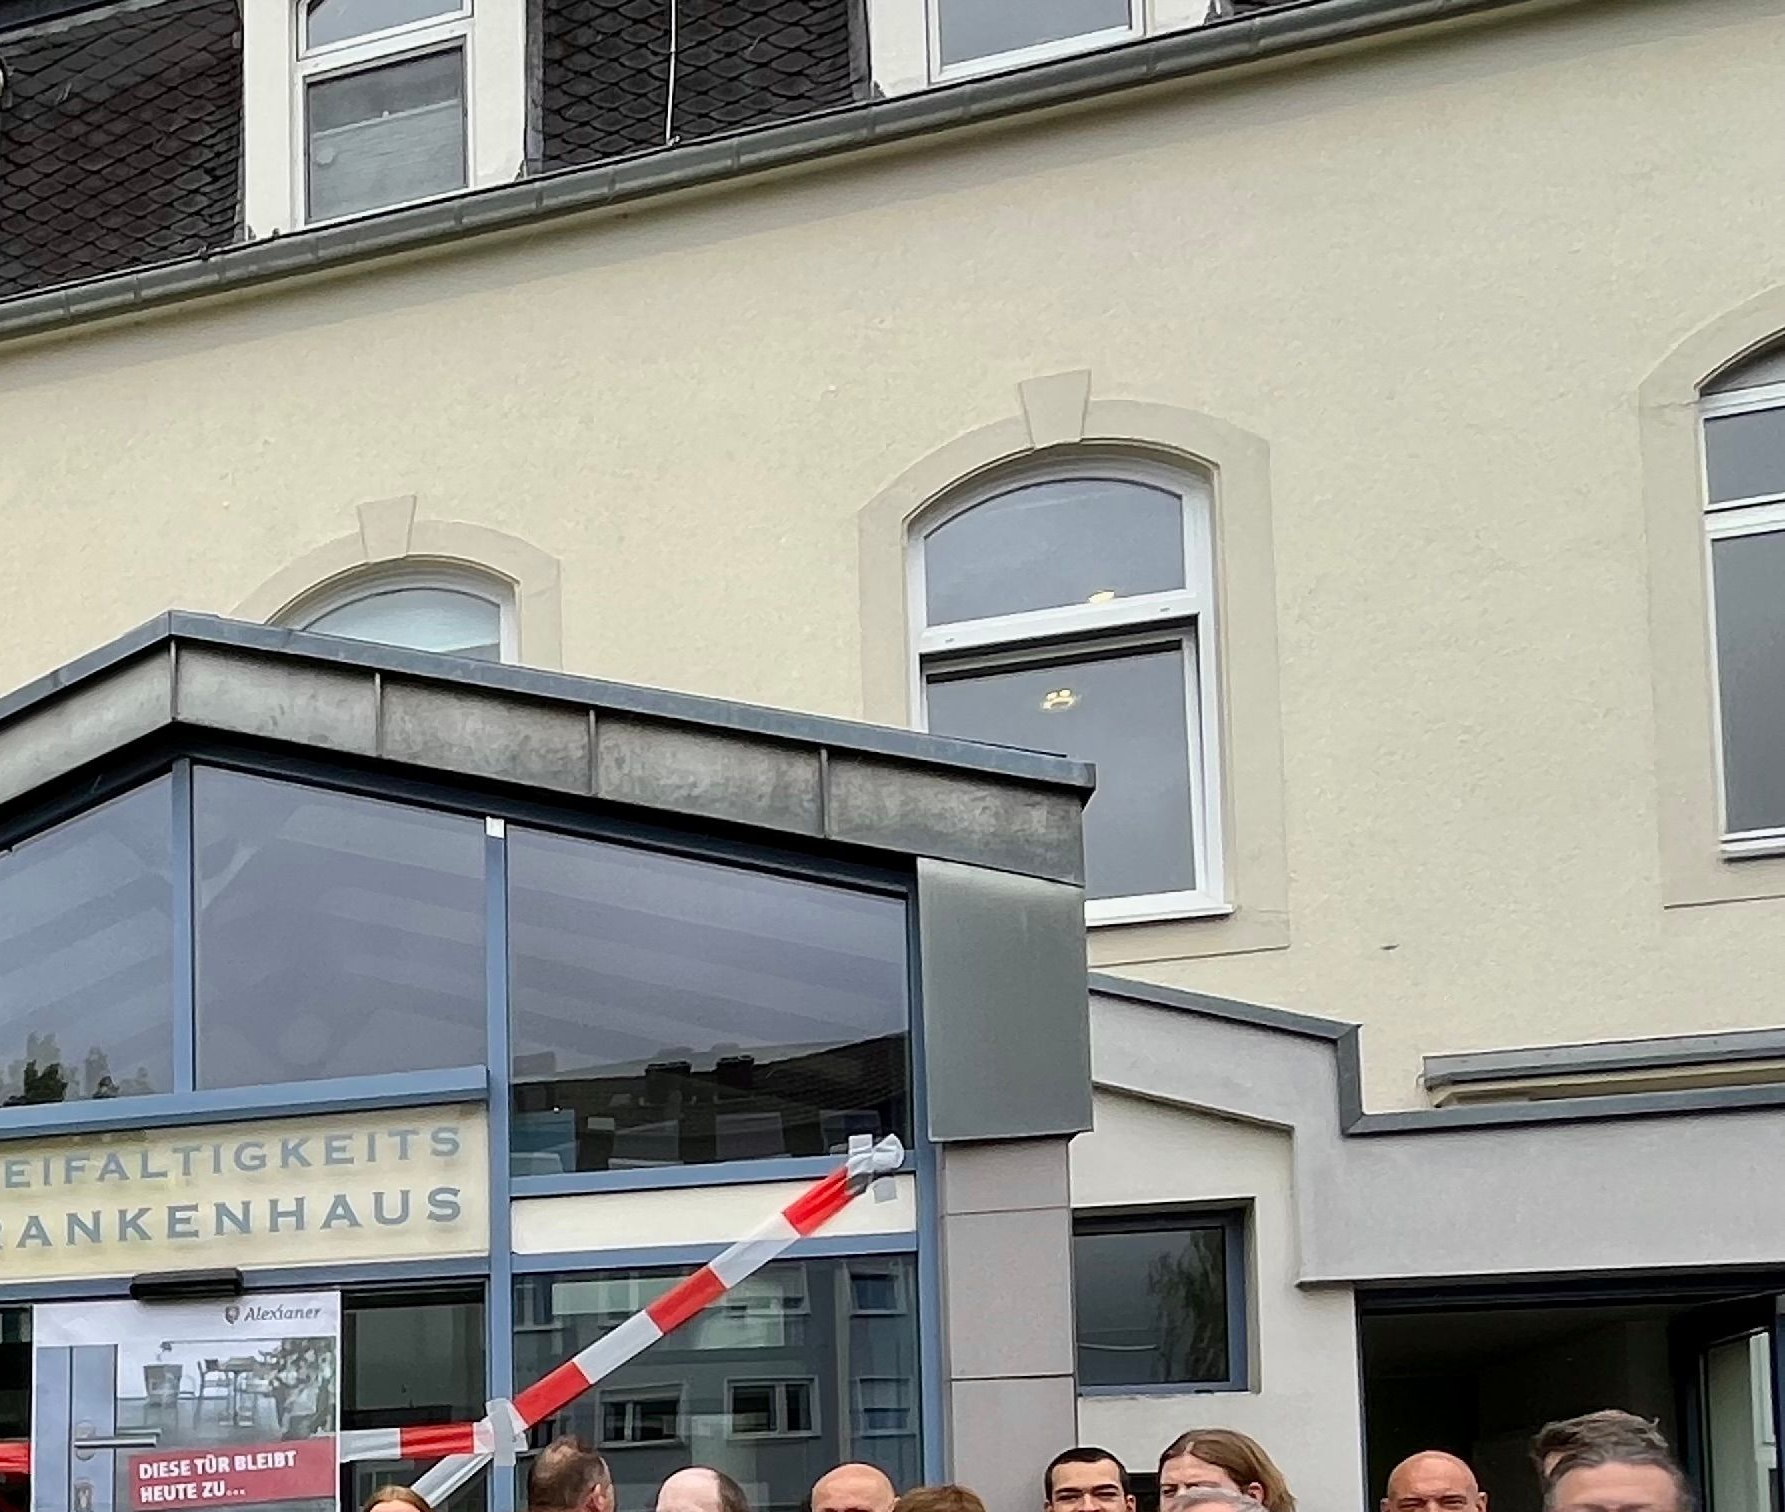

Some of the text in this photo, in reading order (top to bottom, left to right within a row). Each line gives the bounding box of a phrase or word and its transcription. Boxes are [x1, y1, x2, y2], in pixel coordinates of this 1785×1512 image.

[244, 1304, 321, 1321] Alexianer
[139, 1450, 297, 1479] DIESE TÜR BLEIBT
[140, 1482, 197, 1503] HEUTE
